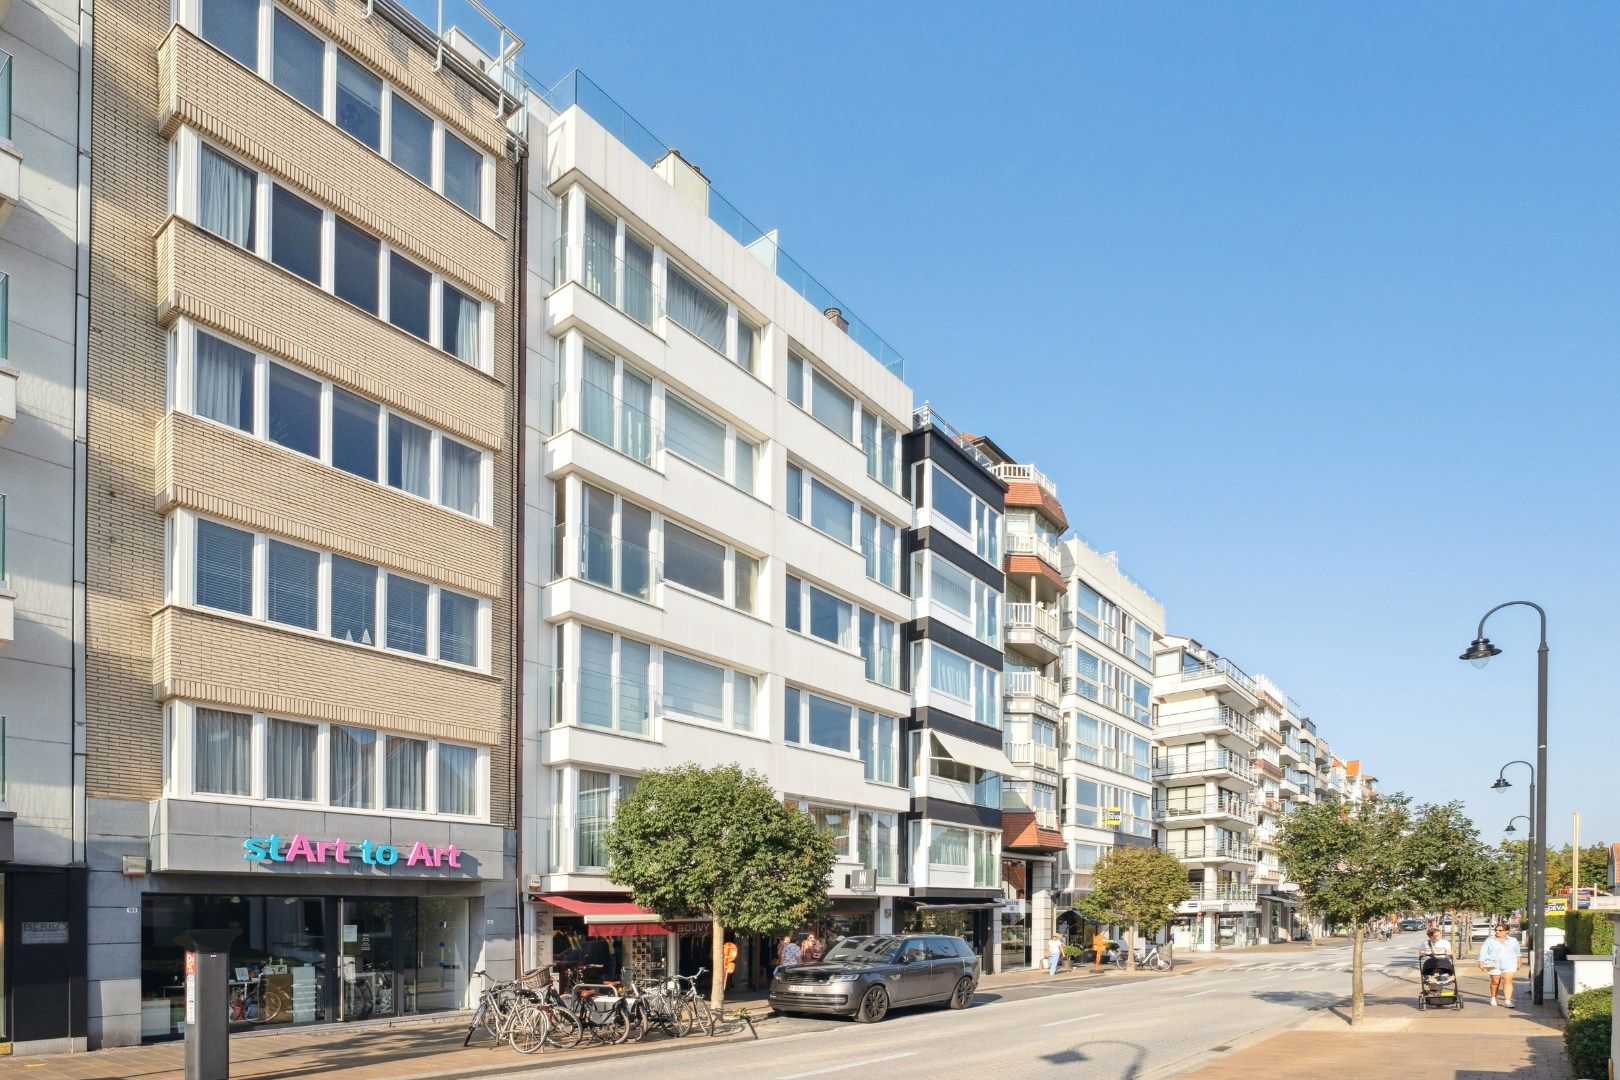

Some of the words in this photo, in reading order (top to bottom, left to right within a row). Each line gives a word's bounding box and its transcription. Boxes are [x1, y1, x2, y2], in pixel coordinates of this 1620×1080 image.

[243, 833, 349, 864] stArt
[359, 839, 399, 866] to
[406, 841, 462, 868] Art
[23, 922, 69, 932] BERKO
[677, 923, 710, 932] BOUVY
